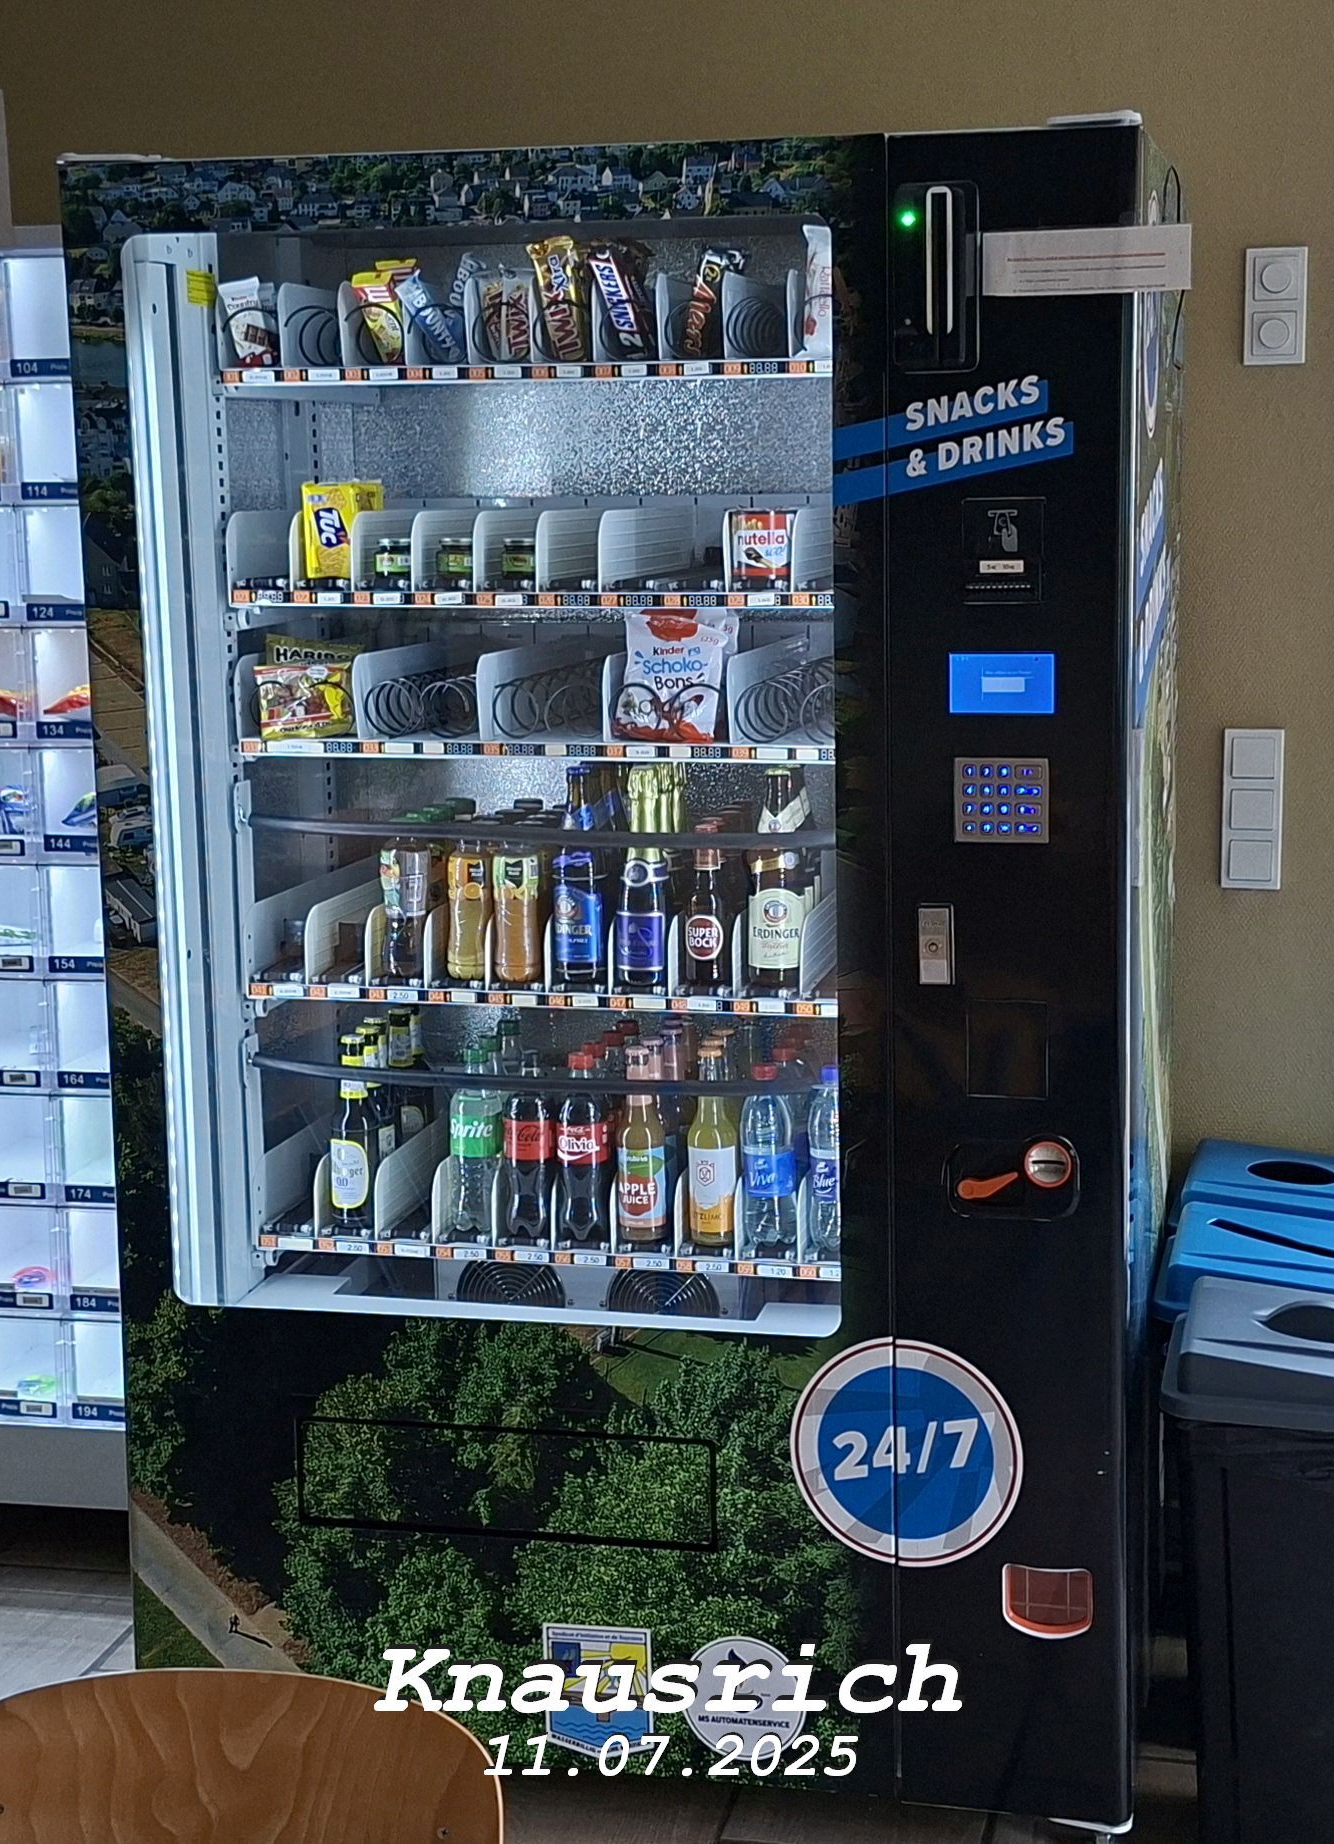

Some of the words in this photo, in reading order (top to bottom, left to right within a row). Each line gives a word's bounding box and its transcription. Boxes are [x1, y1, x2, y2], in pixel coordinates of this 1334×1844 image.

[595, 263, 638, 332] SNICKERS
[16, 362, 39, 373] 104
[905, 375, 1040, 432] SNACKS
[905, 448, 928, 478] &
[937, 416, 1066, 473] DRINKS
[26, 486, 48, 496] 114
[32, 607, 54, 618] 124
[642, 657, 708, 675] Schoko-
[654, 675, 694, 691] Bons
[42, 725, 64, 735] 134
[49, 838, 71, 848] 144
[687, 926, 718, 938] SUPER
[752, 926, 800, 939] ERDINGER
[688, 937, 717, 948] BOCK
[54, 959, 76, 968] 154
[63, 1074, 85, 1084] 164
[450, 1118, 493, 1140] Sprite
[70, 1189, 92, 1198] 174
[618, 1182, 656, 1196] APPLE
[622, 1196, 649, 1205] JUICE
[75, 1297, 97, 1307] 184
[77, 1406, 98, 1416] 194
[832, 1417, 979, 1482] 24/7
[698, 1714, 710, 1722] MS
[711, 1715, 790, 1729] AUTOMATENSERVICE
